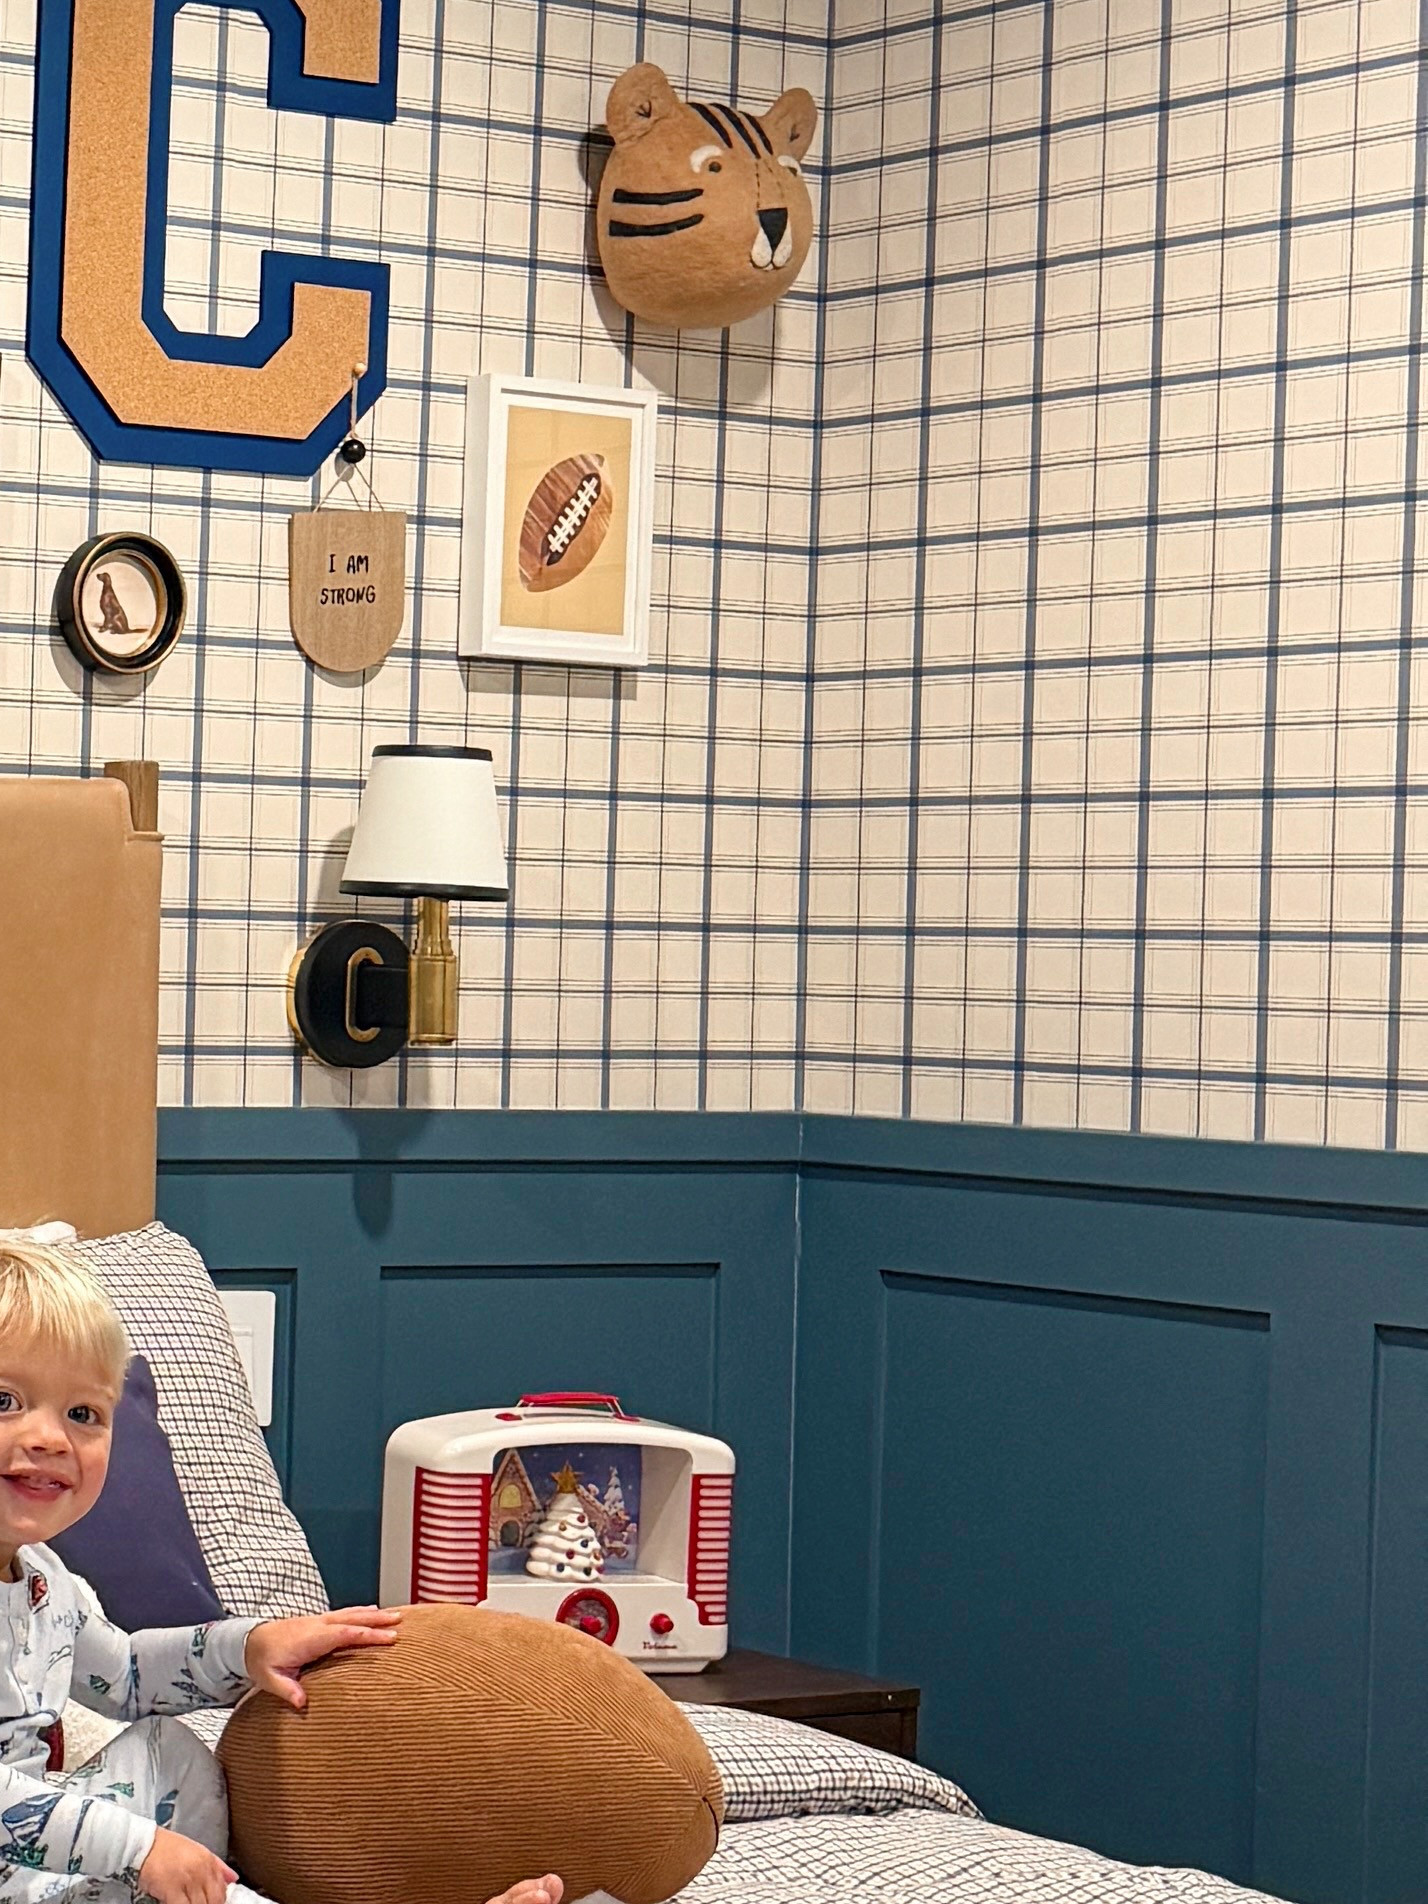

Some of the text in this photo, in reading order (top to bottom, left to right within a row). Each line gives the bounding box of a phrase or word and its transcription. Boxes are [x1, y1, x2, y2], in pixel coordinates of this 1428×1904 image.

[329, 553, 369, 574] I AM
[320, 584, 376, 606] STRONG
